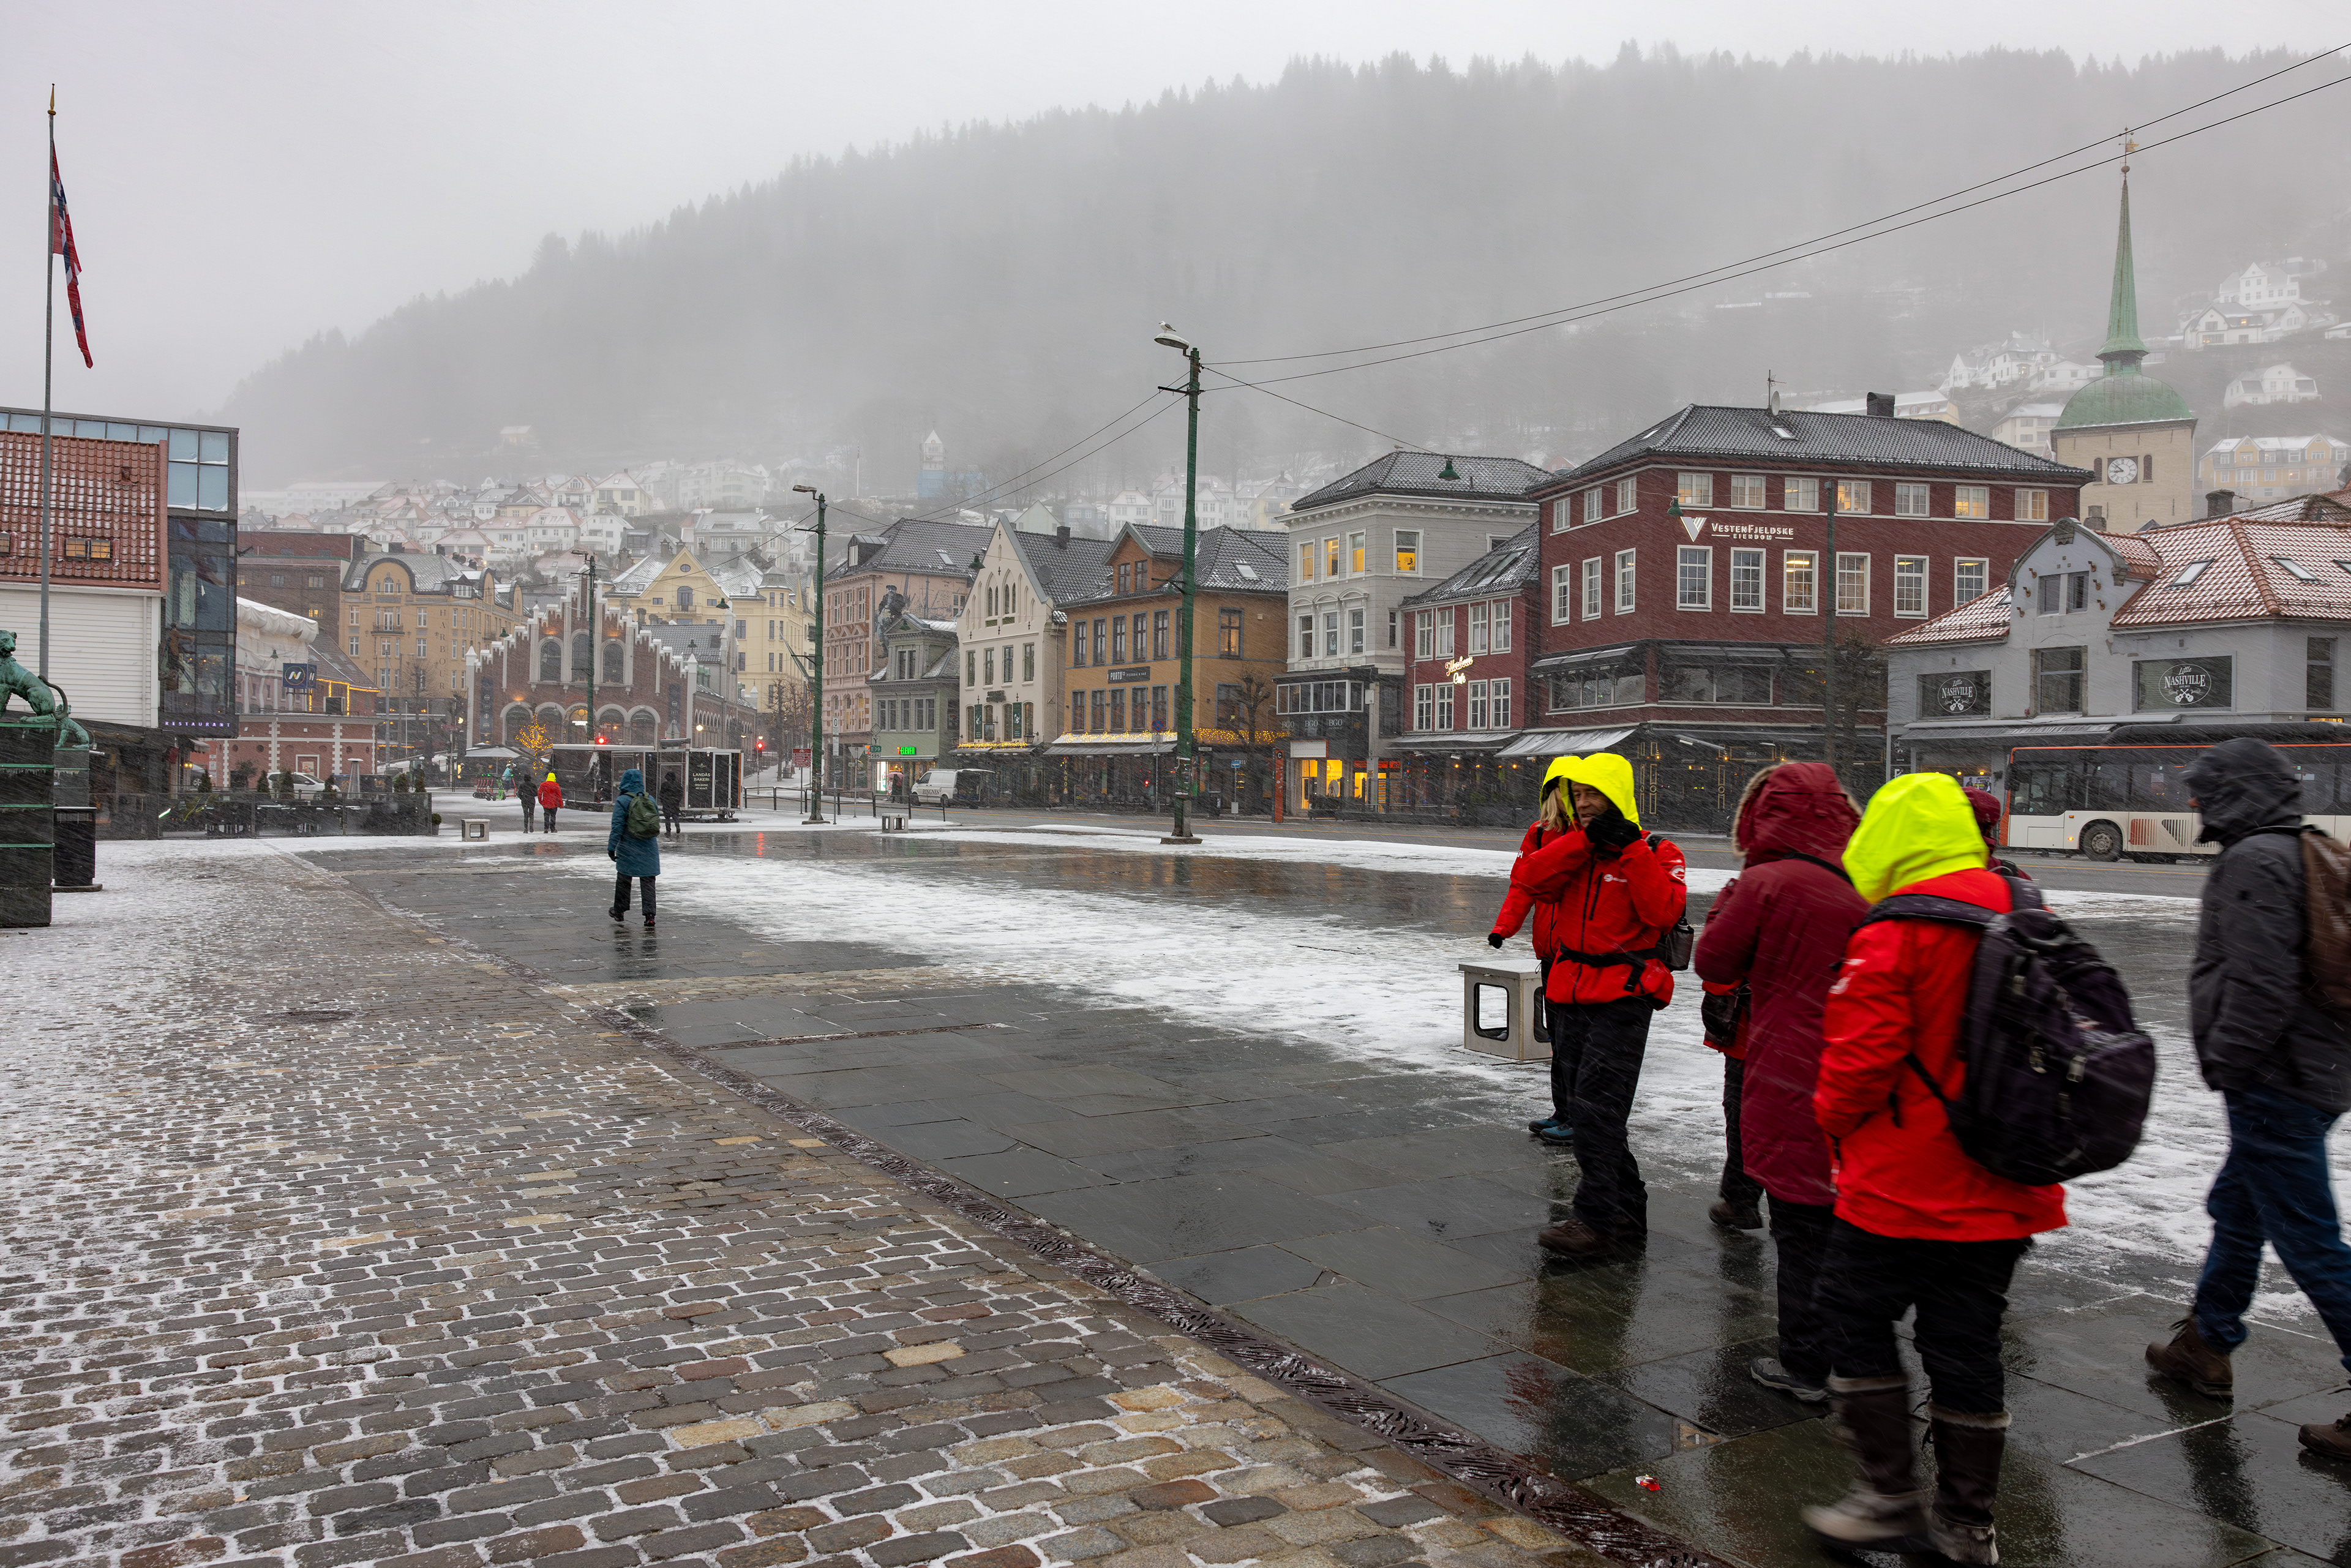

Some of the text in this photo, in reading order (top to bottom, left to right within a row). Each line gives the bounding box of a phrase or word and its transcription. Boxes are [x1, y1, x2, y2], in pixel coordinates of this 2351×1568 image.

[1711, 523, 1794, 536] VESTENFJELDSKE
[2178, 666, 2192, 675] Little
[2164, 675, 2206, 688] NASHVILLE
[1941, 686, 1973, 699] NASHVILLE
